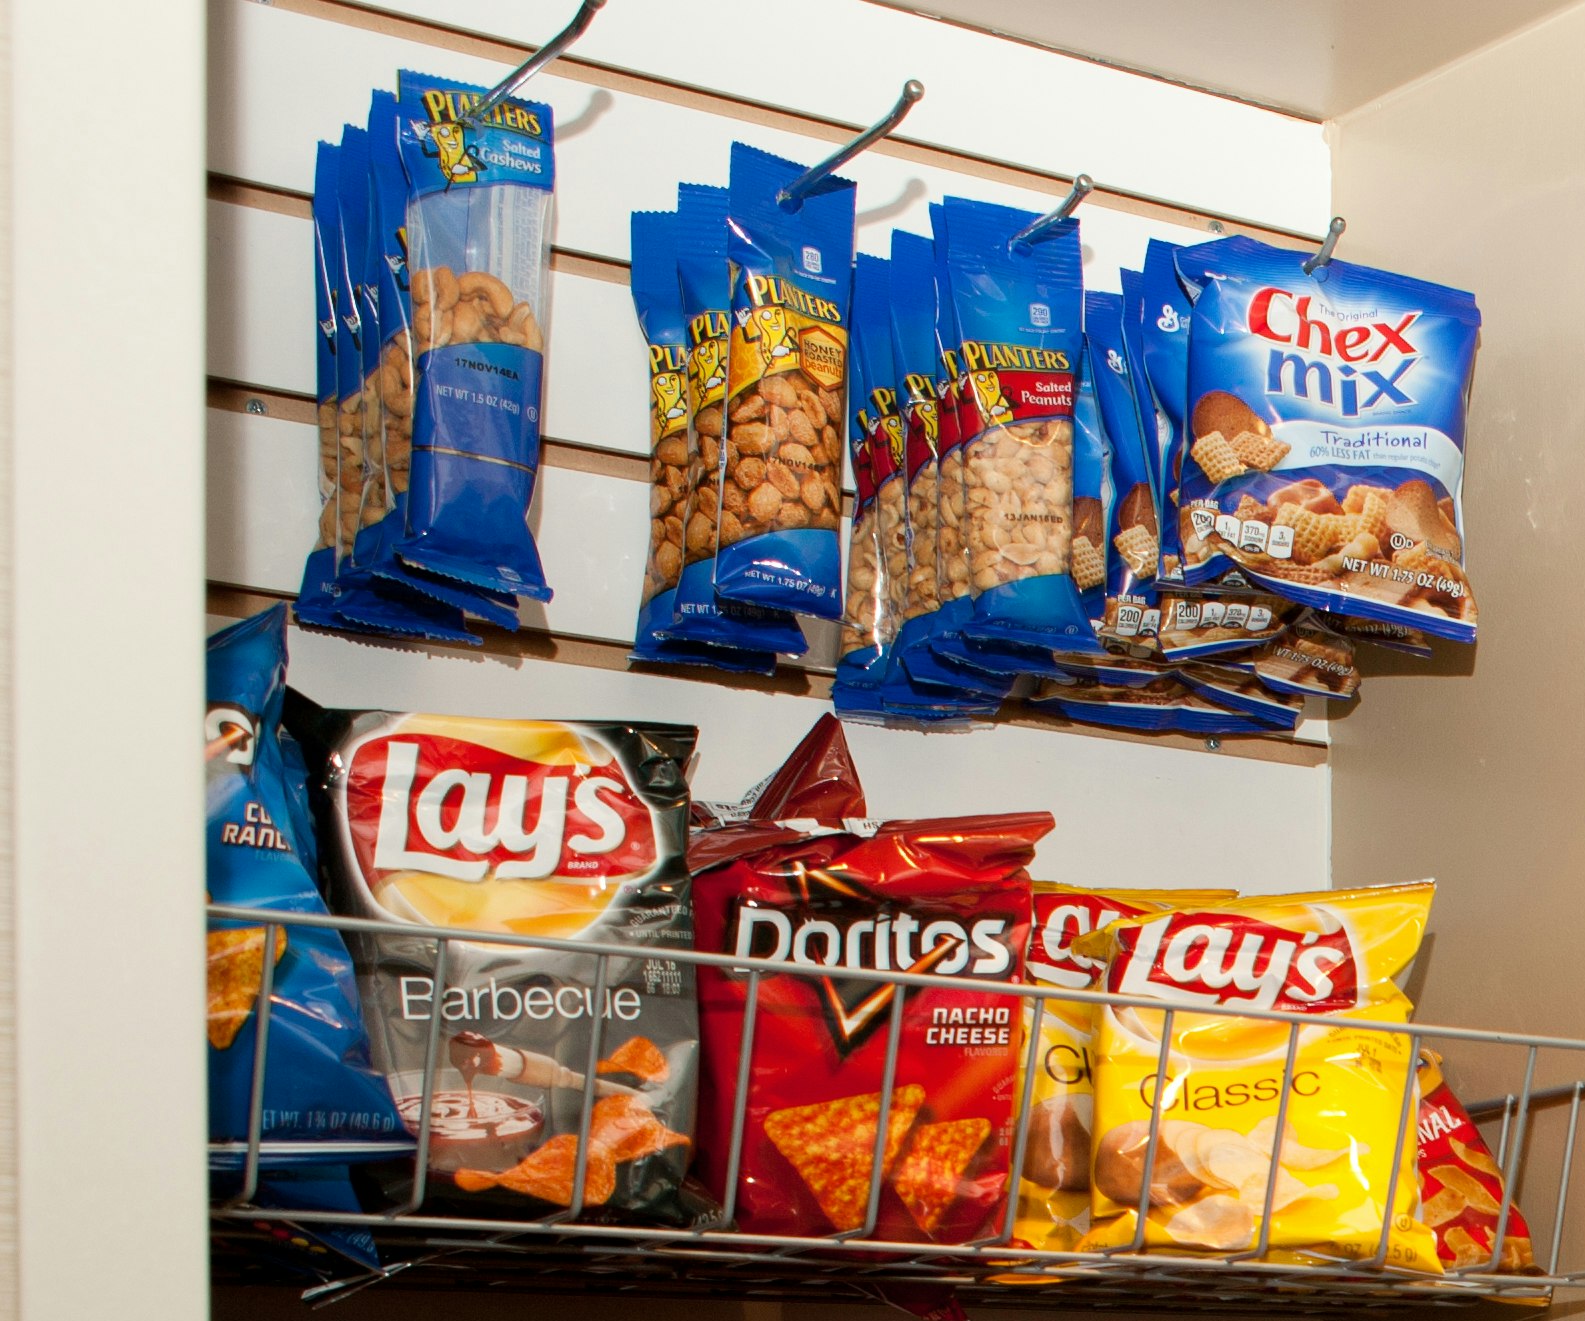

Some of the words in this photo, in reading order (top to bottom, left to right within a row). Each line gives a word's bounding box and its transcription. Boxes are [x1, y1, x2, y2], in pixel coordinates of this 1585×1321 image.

[479, 146, 542, 174] Cashews
[503, 138, 541, 159] Salted
[747, 274, 842, 322] PLANTERS
[1247, 286, 1422, 366] Chex
[1319, 304, 1335, 317] The
[1336, 306, 1379, 323] Original
[804, 338, 842, 355] HONEY
[963, 341, 1070, 372] PLANTERS
[436, 384, 453, 397] NET
[455, 388, 469, 401] WT
[472, 392, 484, 404] 1.5
[487, 394, 498, 408] OZ
[1036, 380, 1071, 394] Salted
[1265, 348, 1426, 418] mix
[1020, 390, 1072, 406] Peanuts
[1320, 430, 1428, 450] Traditional
[1310, 447, 1330, 459] 60%
[1331, 448, 1351, 460] LESS
[1353, 450, 1371, 460] FAT
[1342, 556, 1367, 574] NET
[1370, 561, 1390, 580] WT
[1392, 568, 1414, 585] 1.75
[1417, 573, 1434, 589] OZ
[1436, 576, 1464, 598] (49g)
[373, 741, 626, 882] Lay's
[733, 905, 1014, 974] Doritos
[1107, 914, 1347, 1011] Lay's
[400, 976, 642, 1022] Barbecue
[932, 1007, 1011, 1025] NACHO
[925, 1027, 1011, 1045] CHEESE
